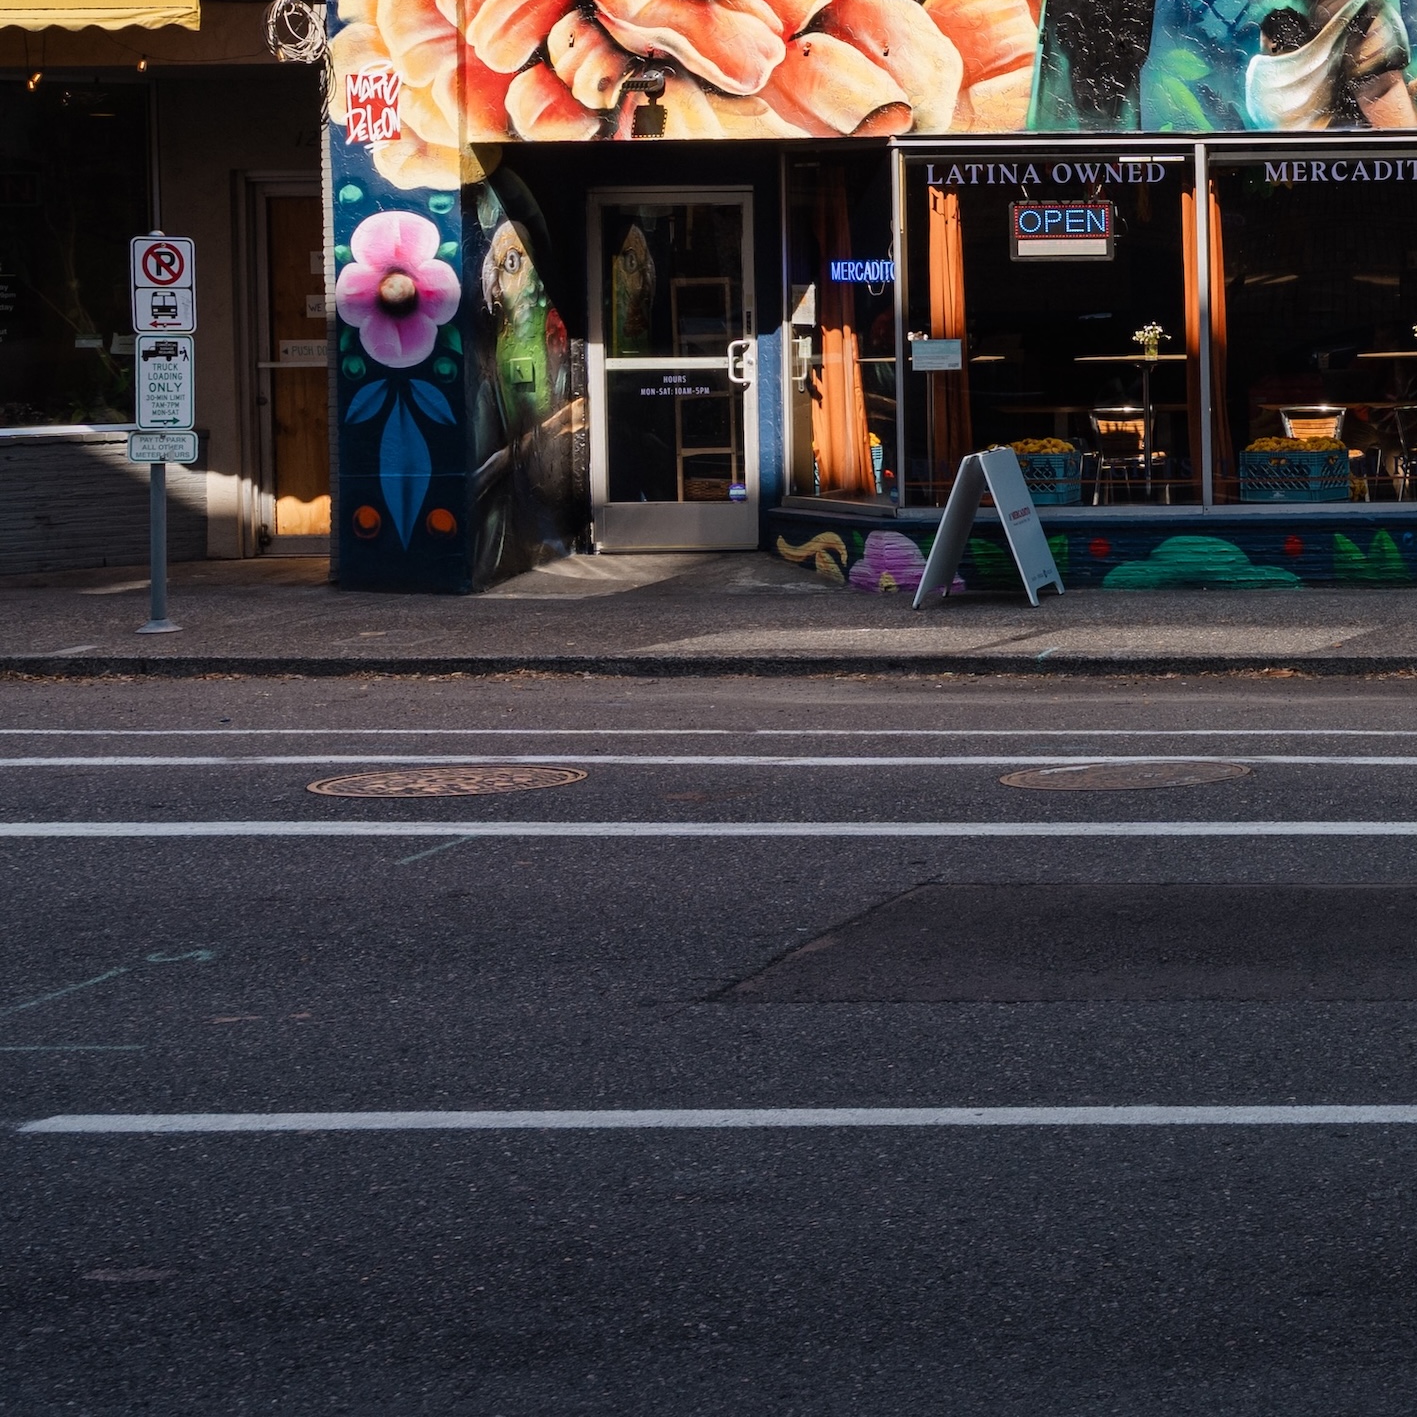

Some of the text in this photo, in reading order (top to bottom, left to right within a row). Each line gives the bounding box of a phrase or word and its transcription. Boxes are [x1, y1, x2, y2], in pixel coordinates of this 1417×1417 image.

[926, 163, 1166, 184] LATINA OWNED
[1018, 209, 1106, 233] OPEN
[291, 345, 314, 356] PUSH
[153, 363, 178, 371] TRUCK
[148, 372, 183, 381] LOADING
[662, 375, 687, 383] HOURS
[148, 382, 182, 393] ONLY
[640, 386, 710, 395] MON-SAT: 10AM-5PM
